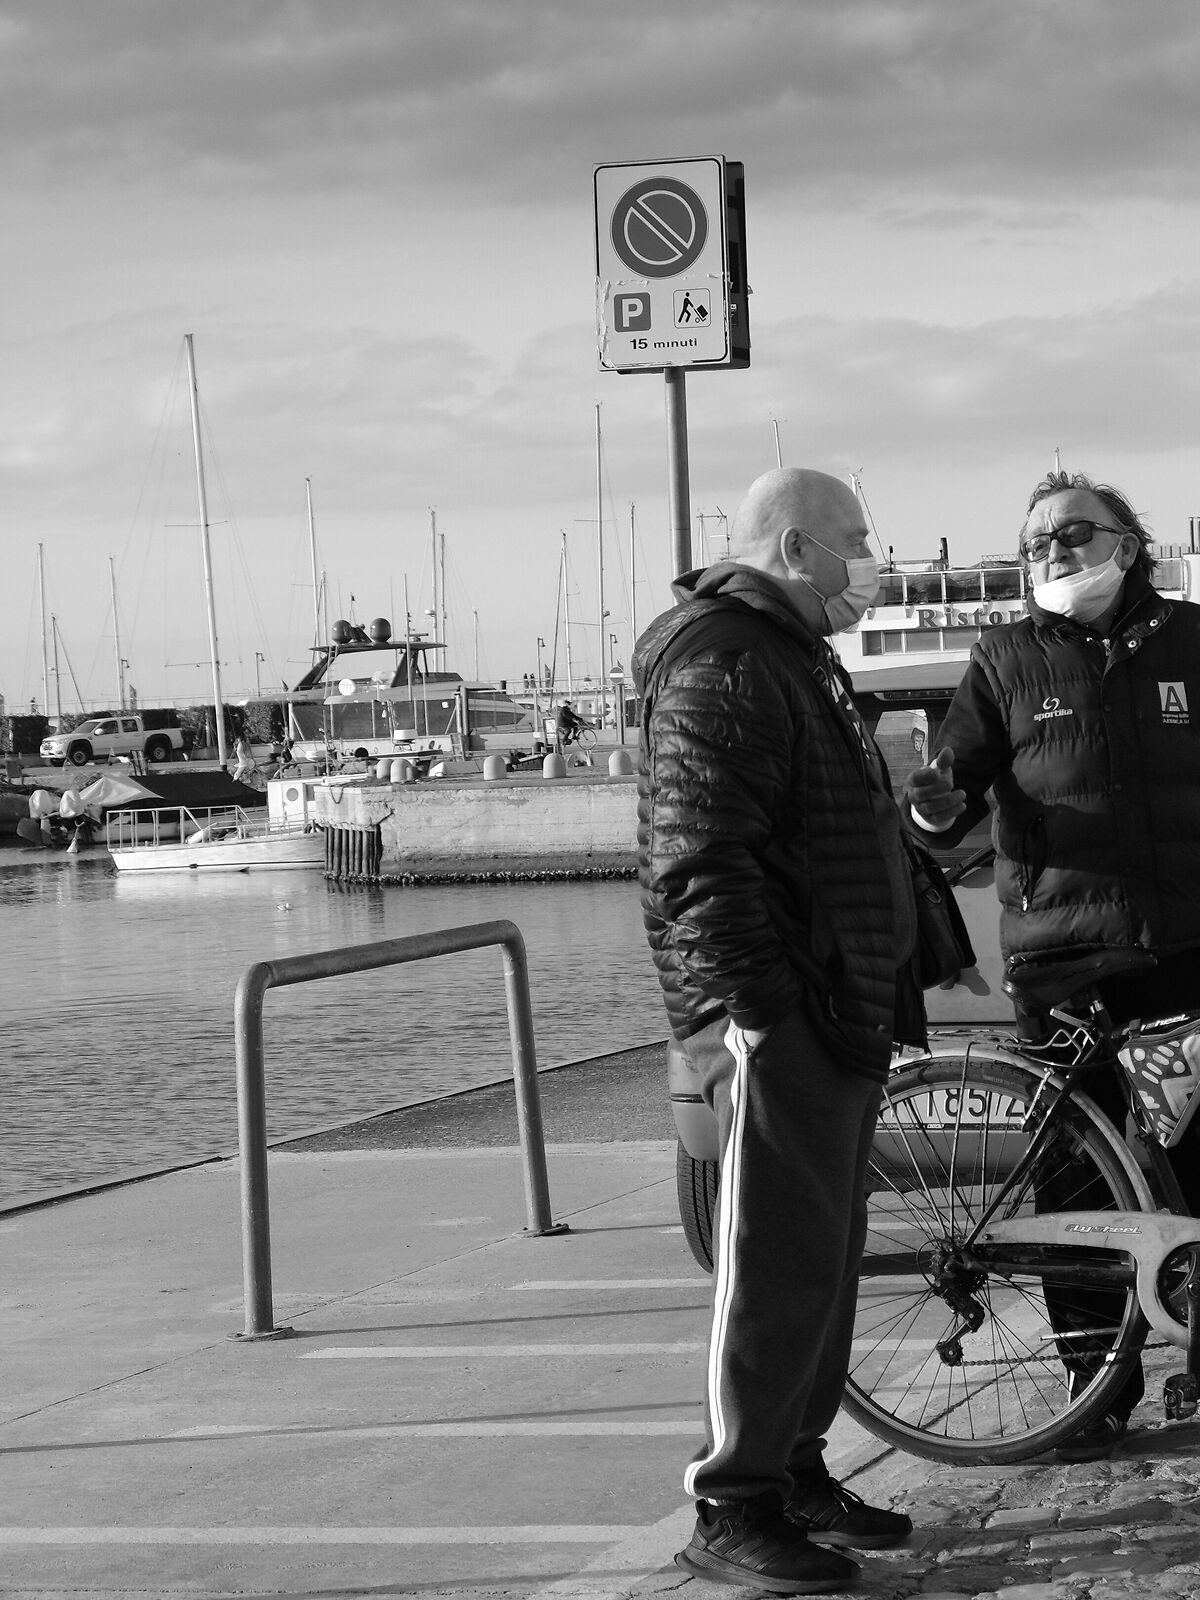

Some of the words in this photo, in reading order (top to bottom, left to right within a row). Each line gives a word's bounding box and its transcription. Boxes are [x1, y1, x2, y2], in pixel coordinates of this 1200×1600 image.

[621, 298, 644, 328] P
[629, 338, 648, 350] 15
[653, 338, 697, 349] minuti
[1165, 685, 1185, 711] A
[1033, 708, 1073, 721] sportika
